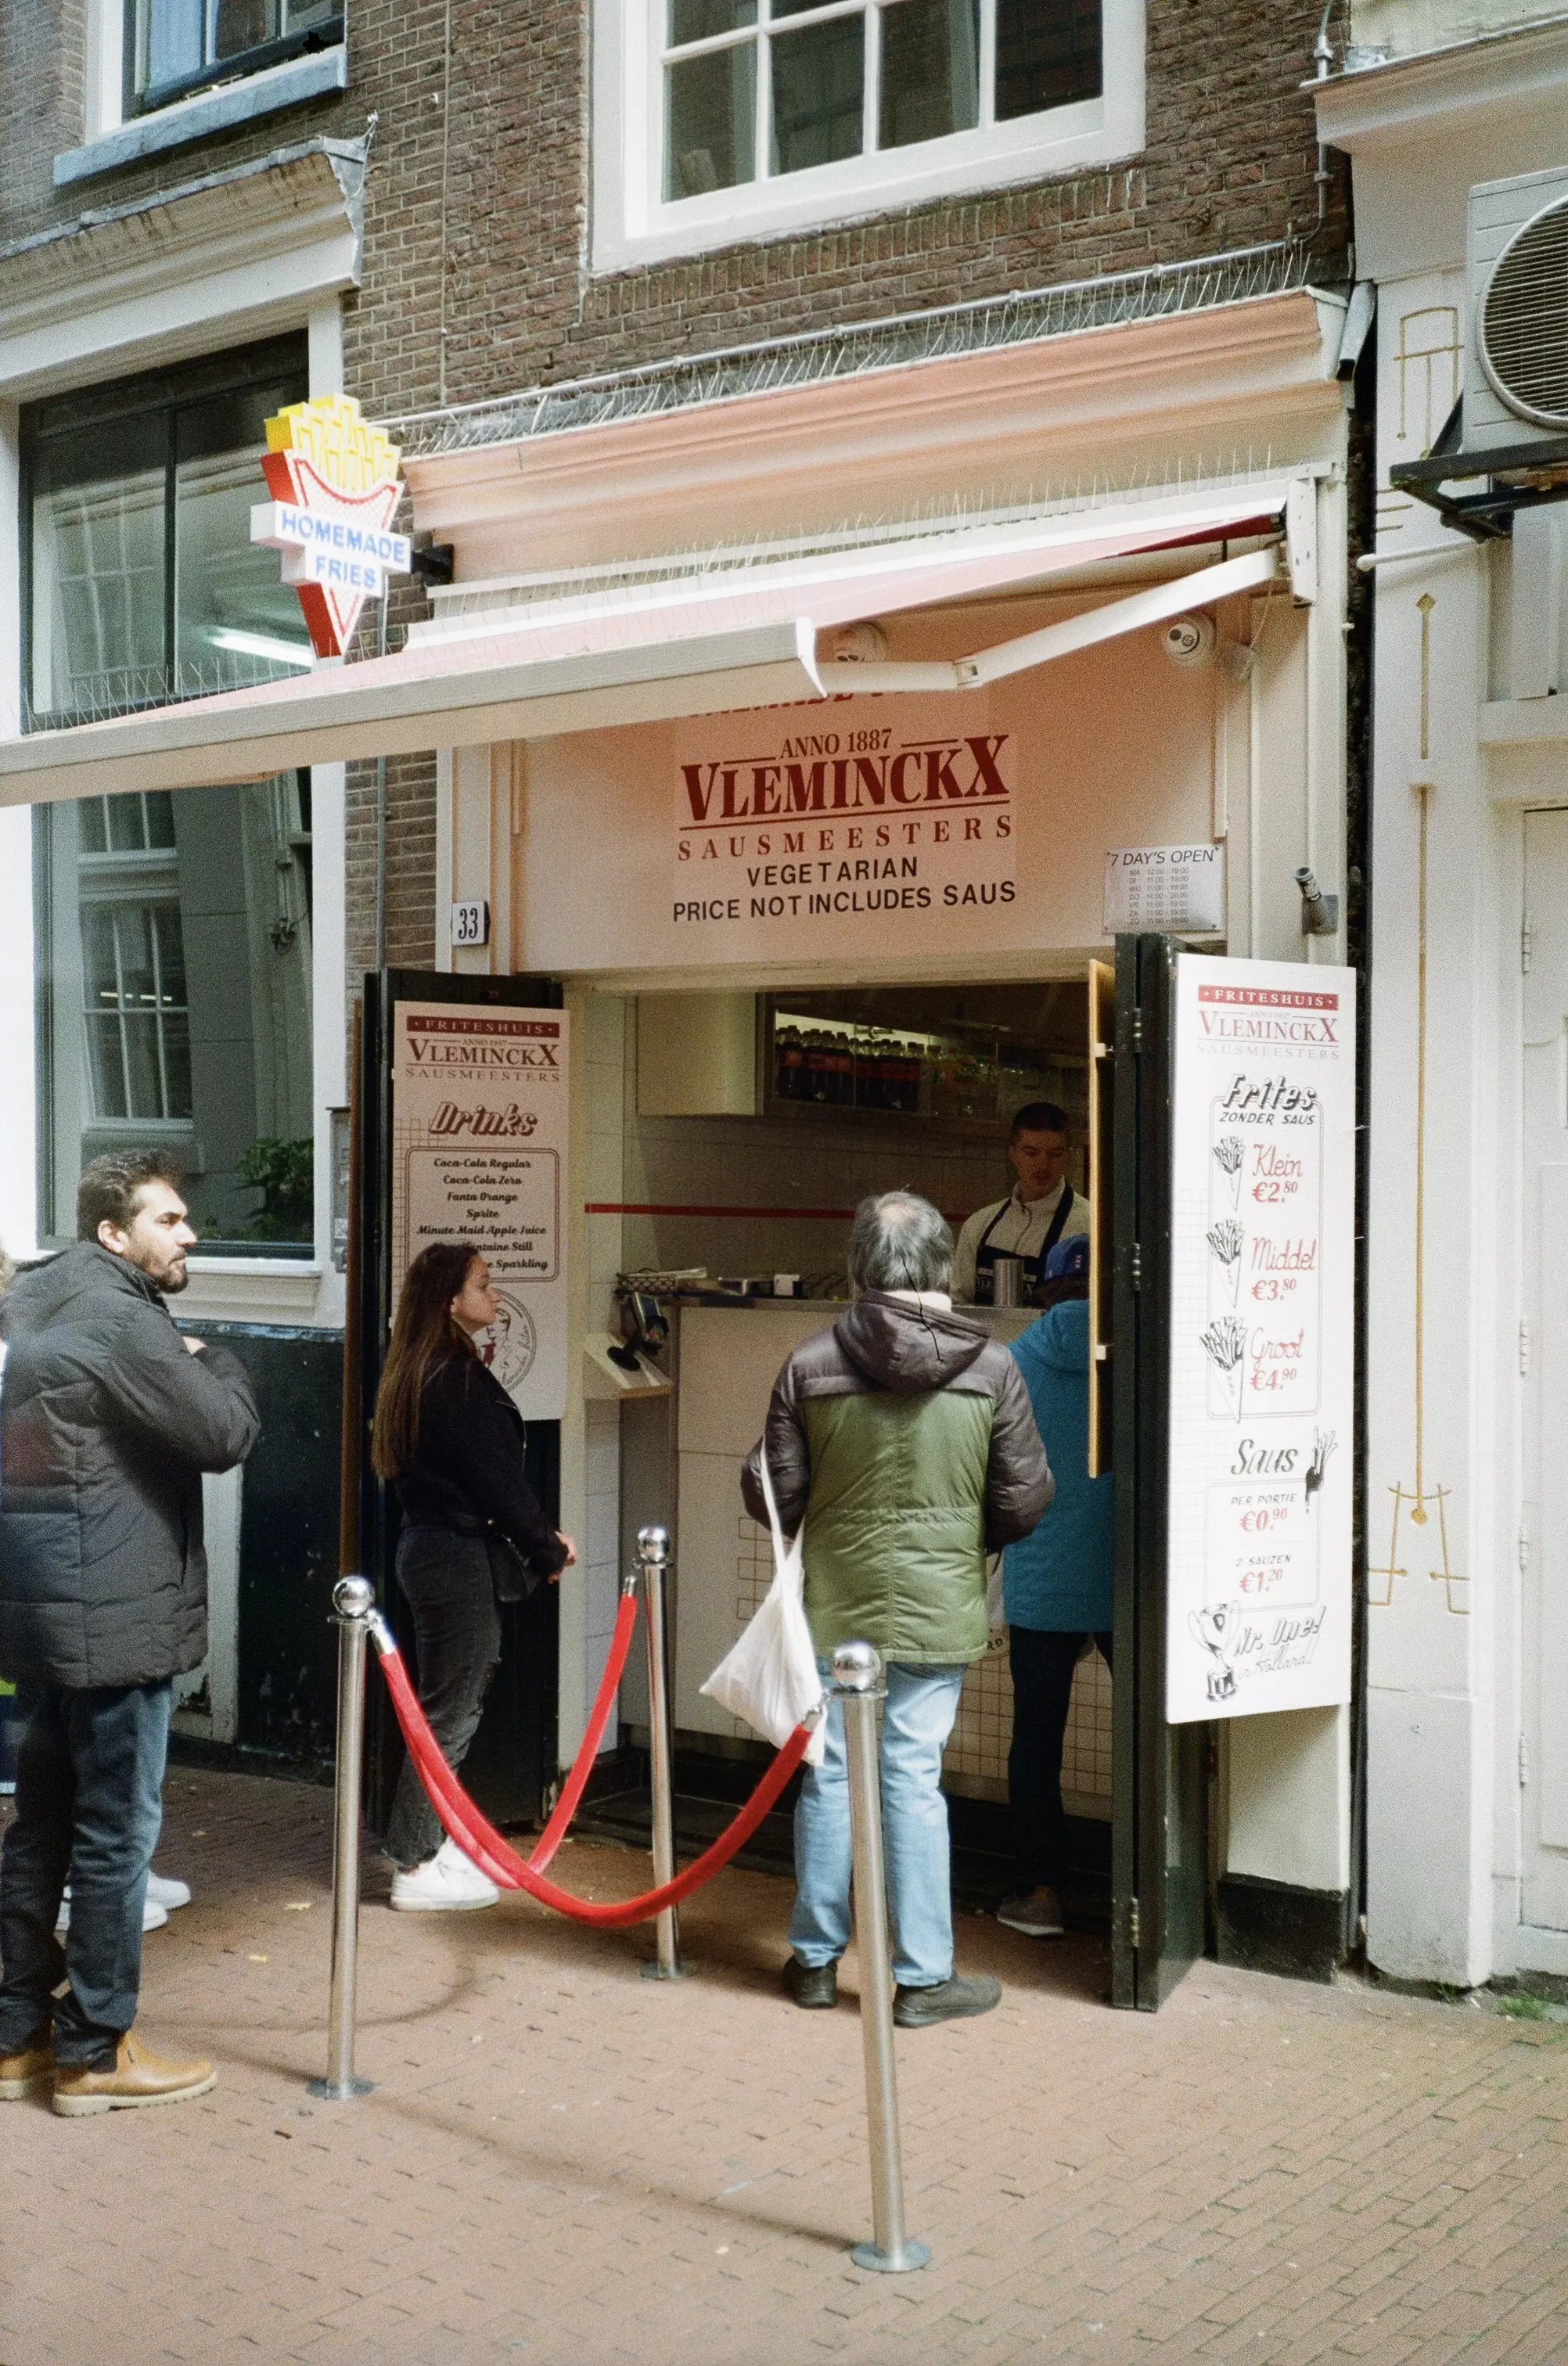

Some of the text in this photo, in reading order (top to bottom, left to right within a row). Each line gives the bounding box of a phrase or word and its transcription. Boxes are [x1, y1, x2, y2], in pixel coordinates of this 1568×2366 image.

[281, 509, 405, 564] HOMEMADE
[315, 555, 376, 590] FRIES
[779, 728, 892, 759] ANNO 1887
[681, 734, 1009, 821] VLEMINCKX
[678, 814, 1012, 861] SAUSMEESTERS
[1110, 850, 1214, 866] 7 DAY'S OPEN
[747, 856, 918, 887] VEGETARIAN
[673, 881, 1016, 922] PRICE NOT INCLUDES SAUS
[458, 908, 478, 940] 33
[1214, 990, 1325, 1007] FRITESHUIS
[426, 1019, 543, 1034] FRITESHUIS
[1199, 1010, 1338, 1043] VLEMINCKX
[407, 1038, 559, 1066] VLEMINCKX
[1196, 1043, 1340, 1060] SAUSMEESTERS
[406, 1068, 560, 1082] SAUSMEESTERS
[1222, 1073, 1317, 1111] Frites
[430, 1101, 538, 1136] Drinks
[1219, 1111, 1316, 1125] ZONDER SAUS
[433, 1157, 531, 1170] Coca-Cola Regular
[1252, 1143, 1303, 1177] Klein
[443, 1175, 523, 1185] Coca-Cola Zero
[1252, 1181, 1299, 1203] €2.80
[447, 1192, 519, 1205] Fanta Orange
[466, 1208, 500, 1221] Sprite
[416, 1225, 547, 1238] Minute Maid Apple Juice
[512, 1241, 533, 1252] Still
[1251, 1236, 1317, 1271] Middel
[496, 1259, 548, 1271] Sparkling
[1250, 1278, 1297, 1300] €3.80
[1250, 1327, 1304, 1371] Groot
[1250, 1368, 1297, 1391] €4.90
[1230, 1438, 1299, 1476] Saus
[1231, 1493, 1297, 1506] PER PORTIE
[1239, 1507, 1288, 1532] €0.90
[1235, 1554, 1293, 1568] 2 SAUZEN
[1239, 1568, 1283, 1594] €1.20
